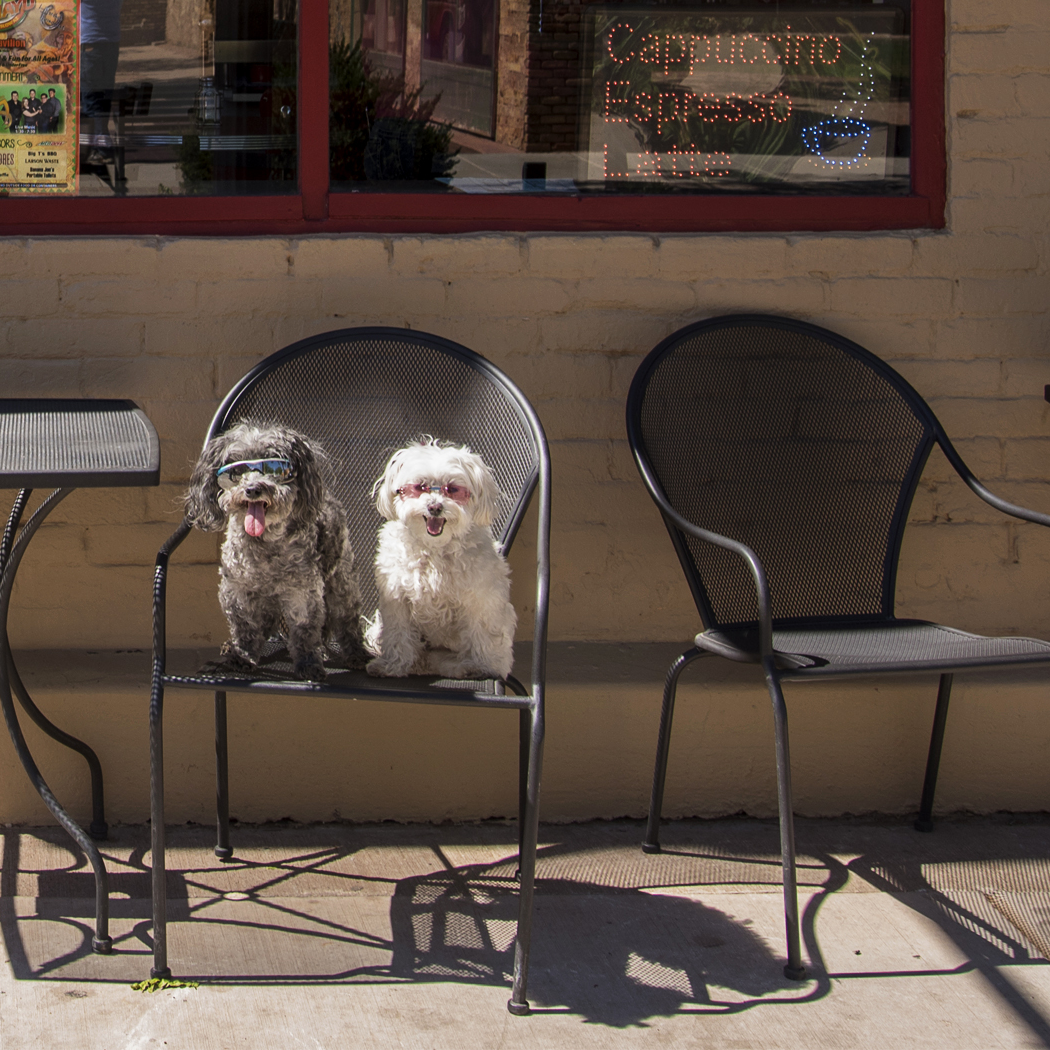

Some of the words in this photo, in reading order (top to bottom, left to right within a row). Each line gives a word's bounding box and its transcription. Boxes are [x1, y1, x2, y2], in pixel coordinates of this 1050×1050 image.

[607, 22, 842, 76] Cappuccino
[605, 80, 793, 135] Espresso
[603, 142, 733, 178] Latte
